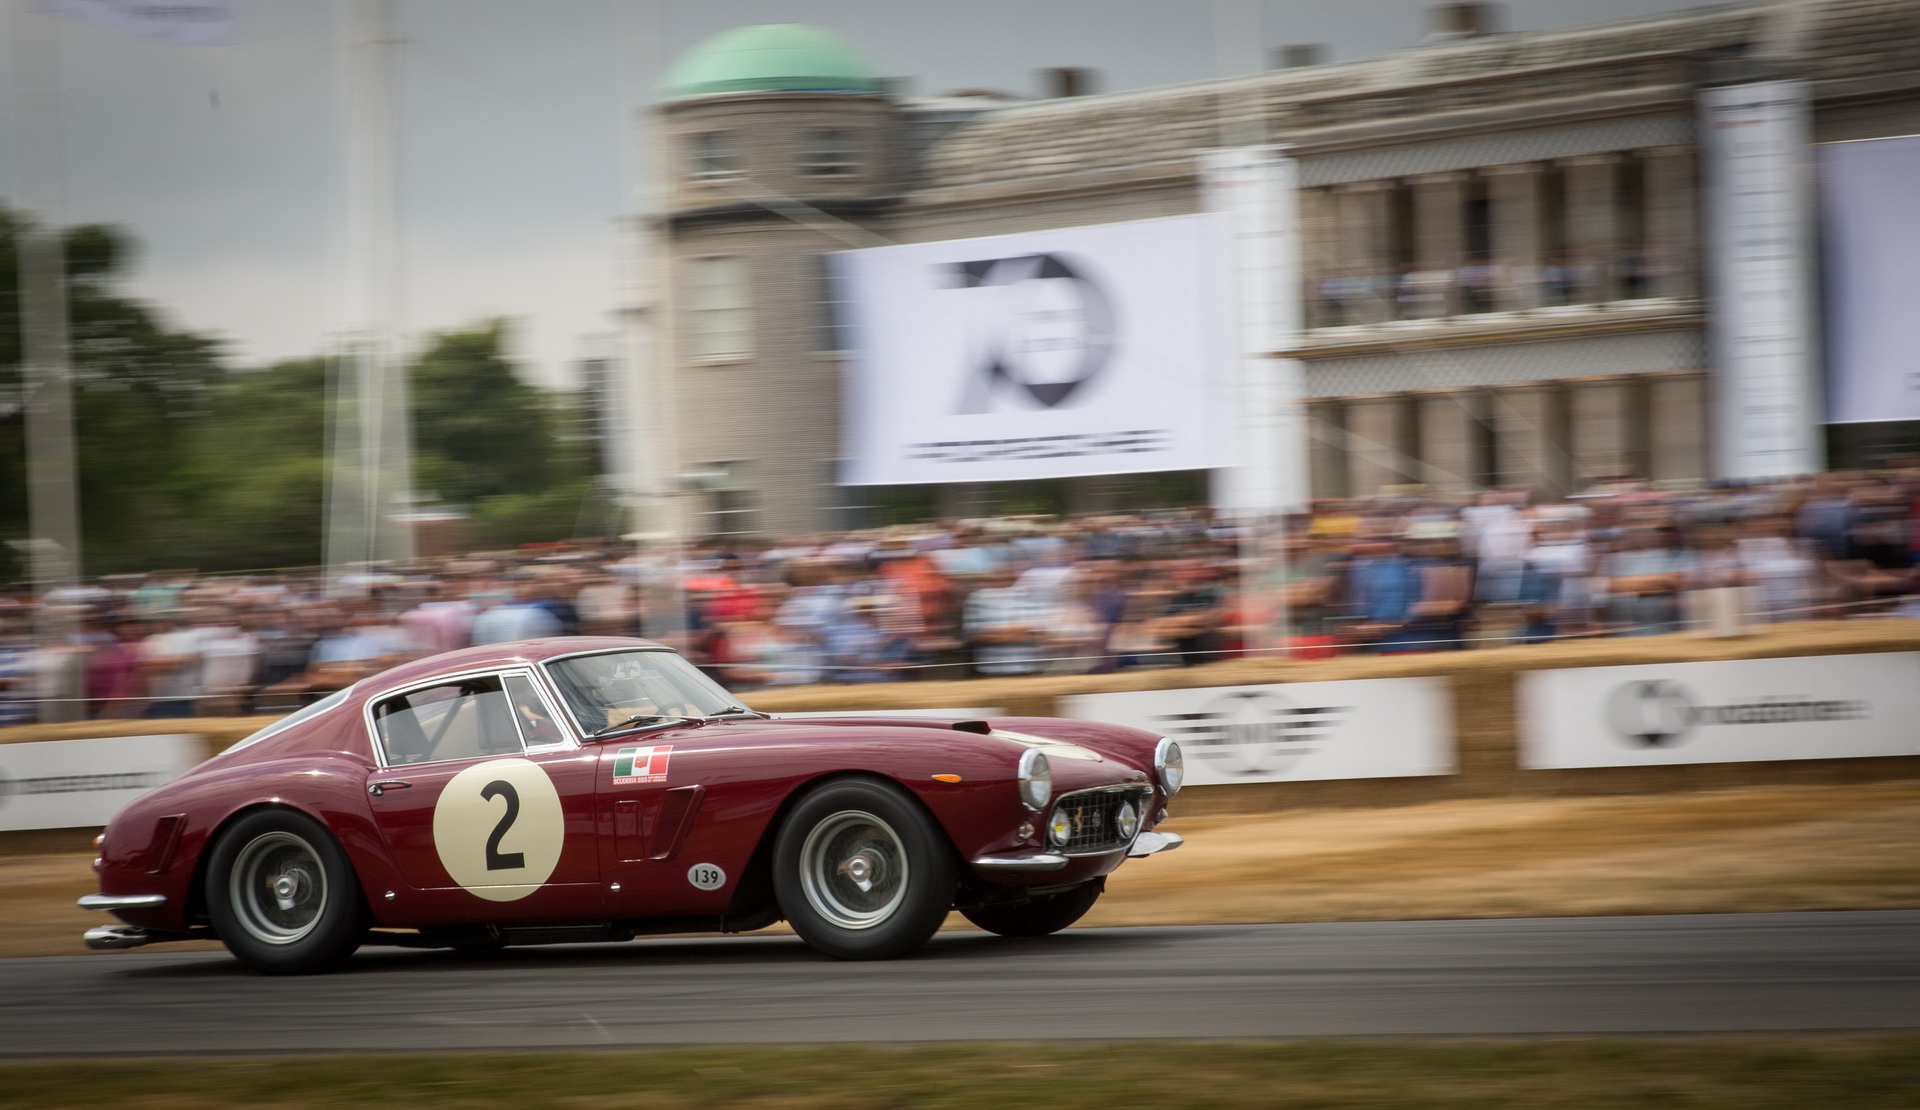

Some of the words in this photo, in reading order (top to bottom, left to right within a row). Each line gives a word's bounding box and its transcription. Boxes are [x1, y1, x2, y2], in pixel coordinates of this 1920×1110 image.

[613, 777, 637, 785] SCUDERIA
[480, 780, 525, 871] 2
[695, 869, 718, 884] 139
